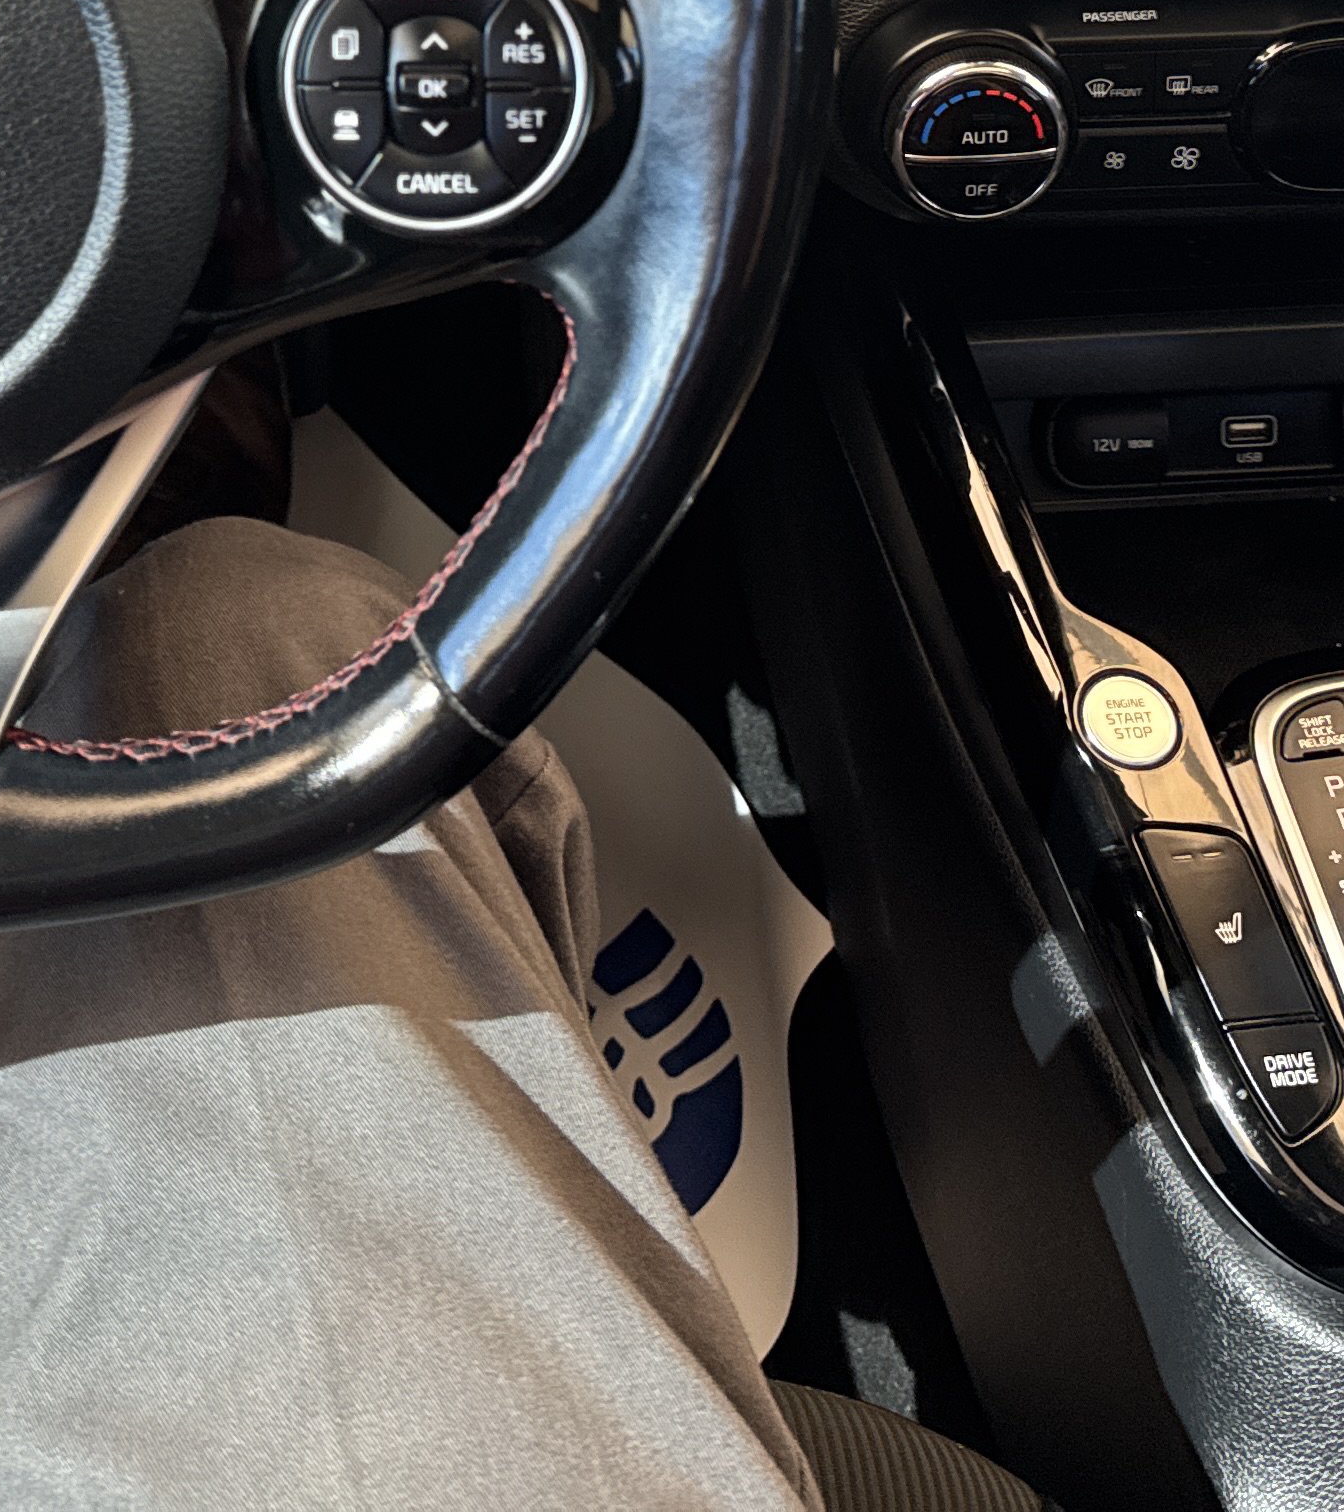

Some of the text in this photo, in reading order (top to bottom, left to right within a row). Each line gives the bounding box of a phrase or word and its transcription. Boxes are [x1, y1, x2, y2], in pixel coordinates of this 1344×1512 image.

[1082, 9, 1157, 22] PASSENGER
[502, 43, 545, 64] RES
[418, 80, 448, 99] OK
[1110, 88, 1143, 97] FRONT
[1191, 85, 1219, 94] REAR
[506, 109, 547, 130] SET
[961, 130, 1009, 146] AUTO
[396, 172, 478, 194] CANCEL
[965, 183, 998, 197] OFF
[1092, 438, 1121, 452] 12V
[1236, 452, 1264, 463] USB
[1106, 698, 1145, 709] ENGINE
[1106, 711, 1151, 725] START
[1298, 714, 1331, 728] SHIFT
[1114, 726, 1152, 739] STOP
[1304, 726, 1335, 738] LOCK
[1324, 775, 1344, 798] P
[1263, 1051, 1315, 1072] DRIVE
[1270, 1067, 1319, 1088] MODE
